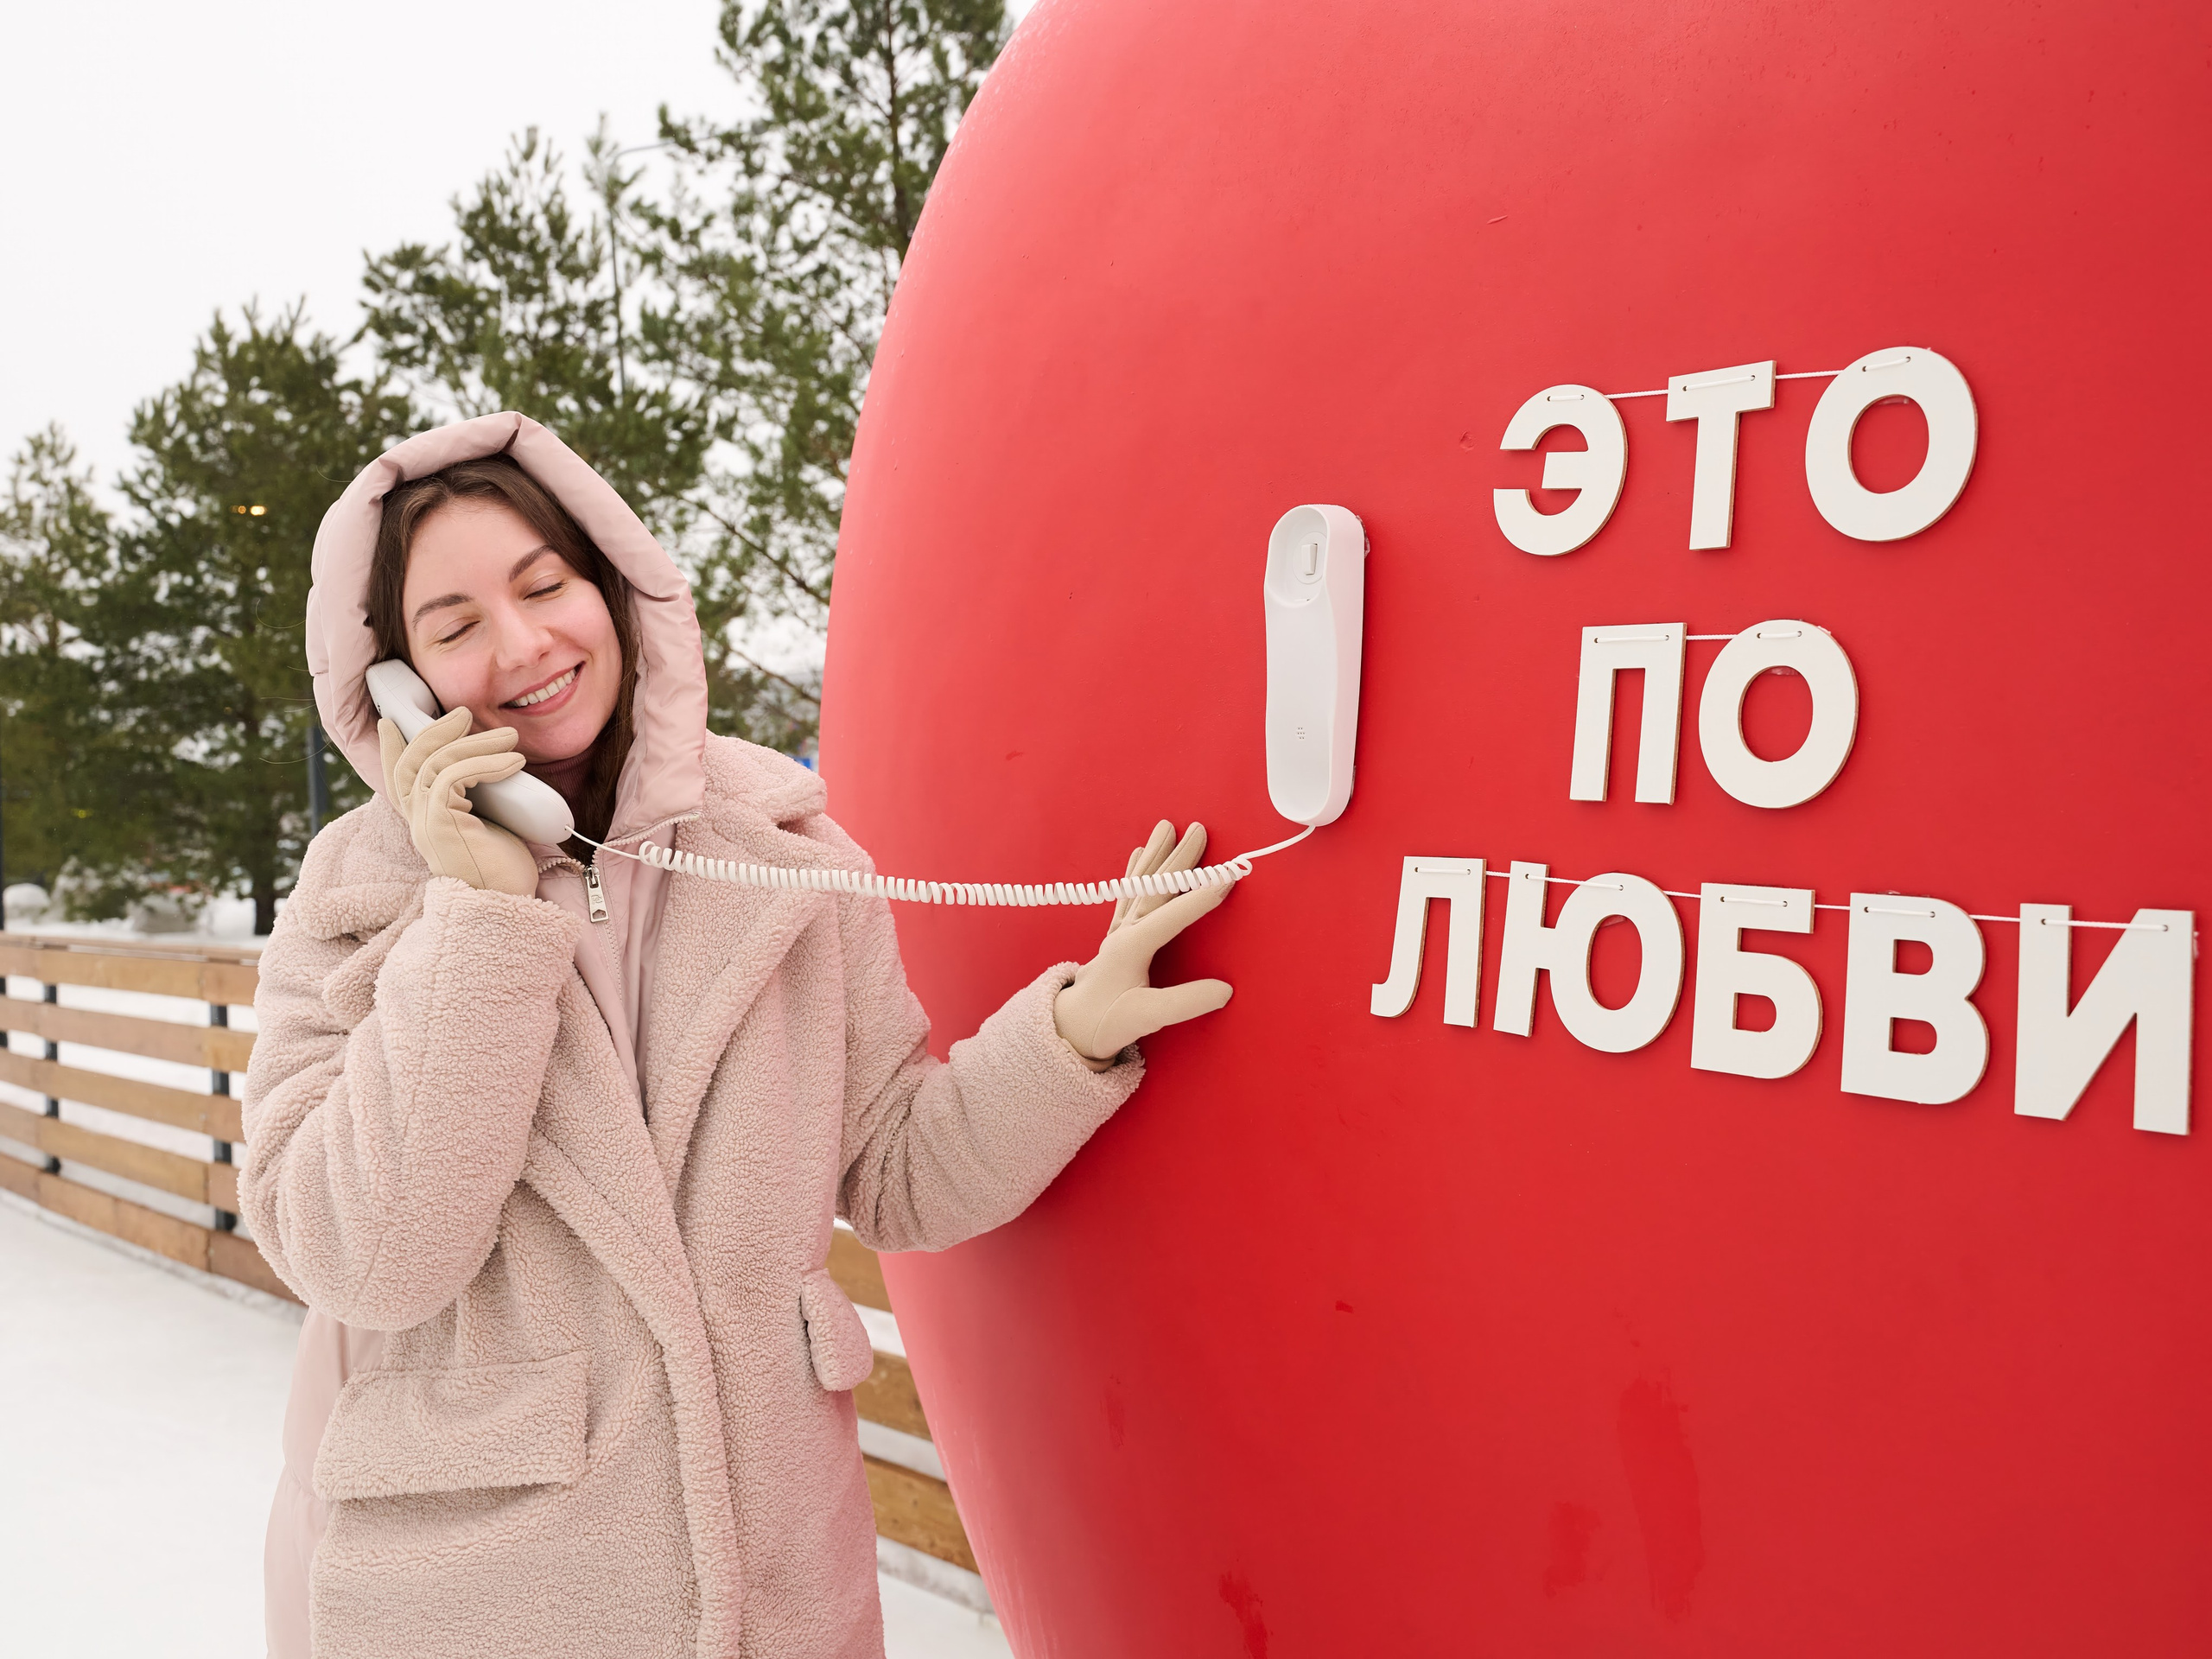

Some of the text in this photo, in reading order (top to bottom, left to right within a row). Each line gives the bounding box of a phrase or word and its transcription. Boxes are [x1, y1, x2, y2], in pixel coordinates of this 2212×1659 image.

[1494, 346, 1978, 556] ЭТО
[1570, 620, 1859, 809] ПО
[1370, 856, 2195, 1135] ЛЮБВИ
